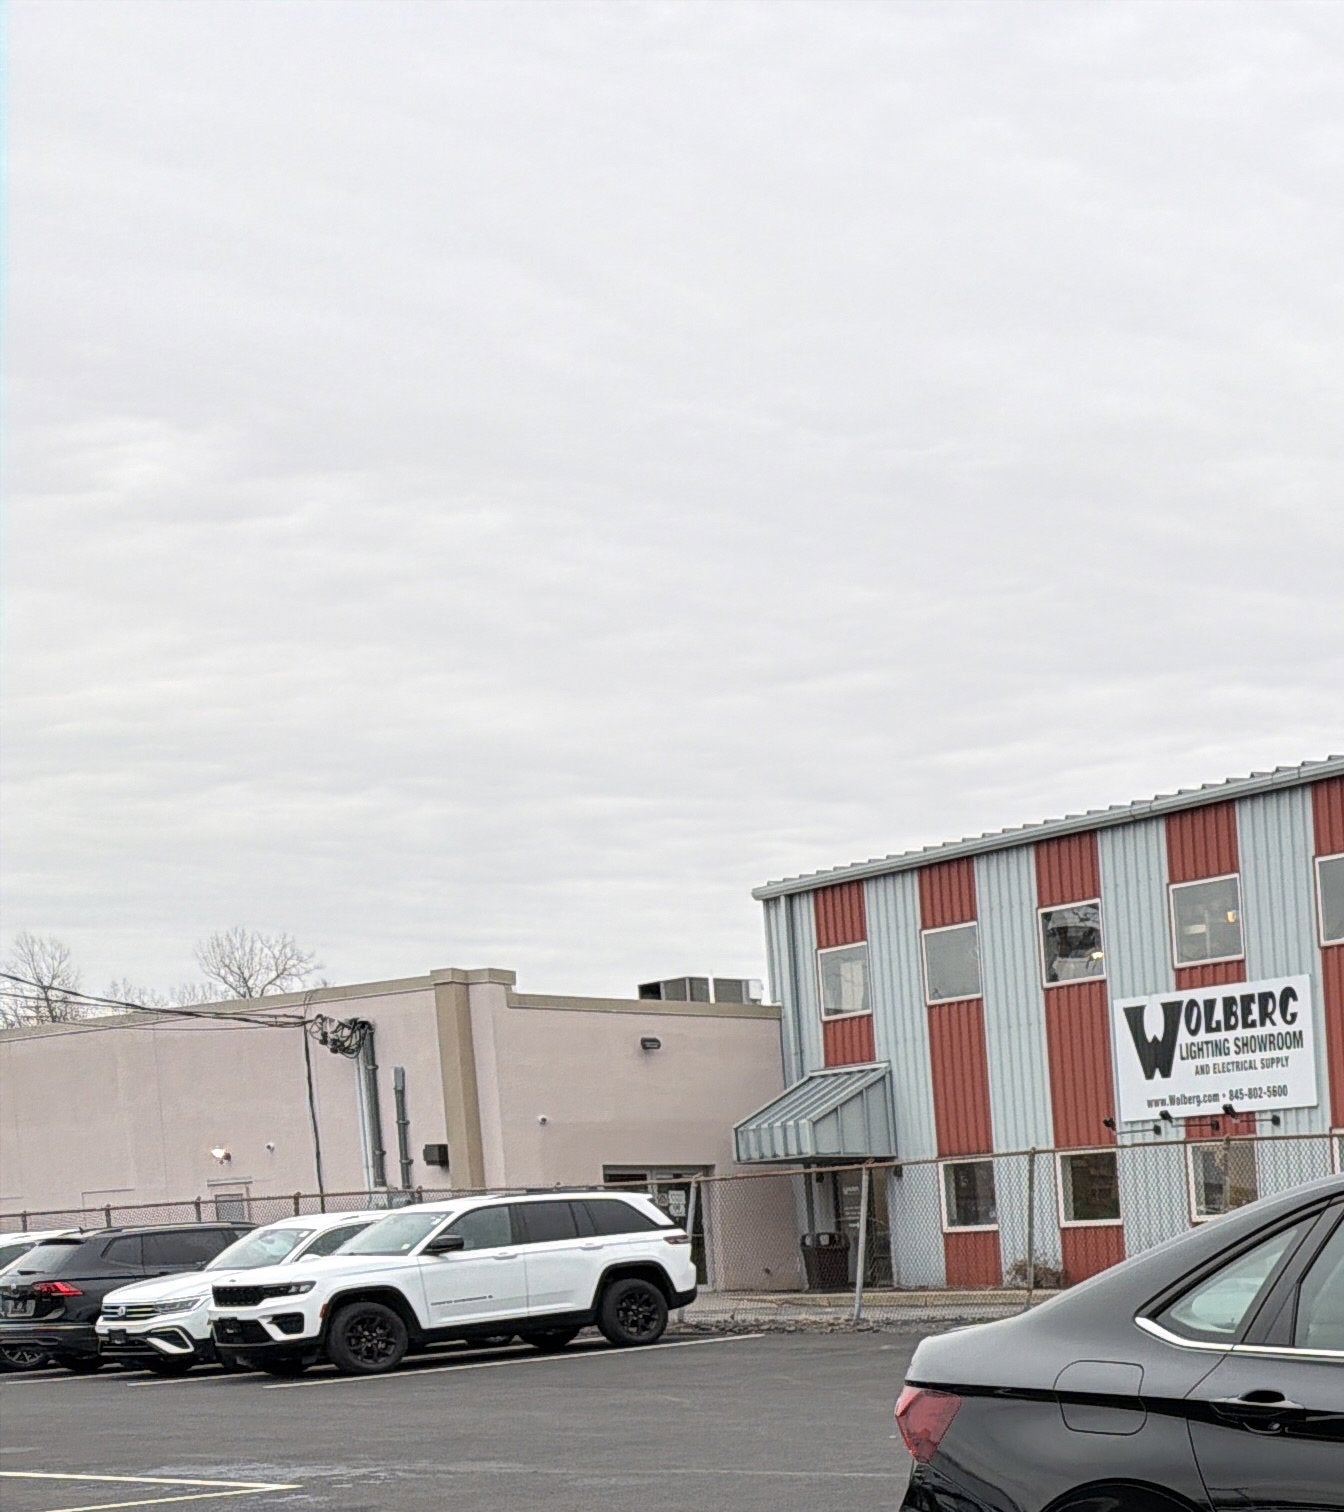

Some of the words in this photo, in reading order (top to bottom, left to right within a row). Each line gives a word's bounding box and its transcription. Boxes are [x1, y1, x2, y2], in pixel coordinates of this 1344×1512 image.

[1123, 986, 1298, 1081] WOLBERG
[1179, 1038, 1230, 1061] LIGHTING
[1233, 1030, 1304, 1055] SHOWROOM
[1195, 1063, 1210, 1076] AND
[1213, 1059, 1258, 1074] ELECTRICAL
[1261, 1055, 1290, 1070] SUPPLY
[1228, 1084, 1289, 1101] 845-802-5600
